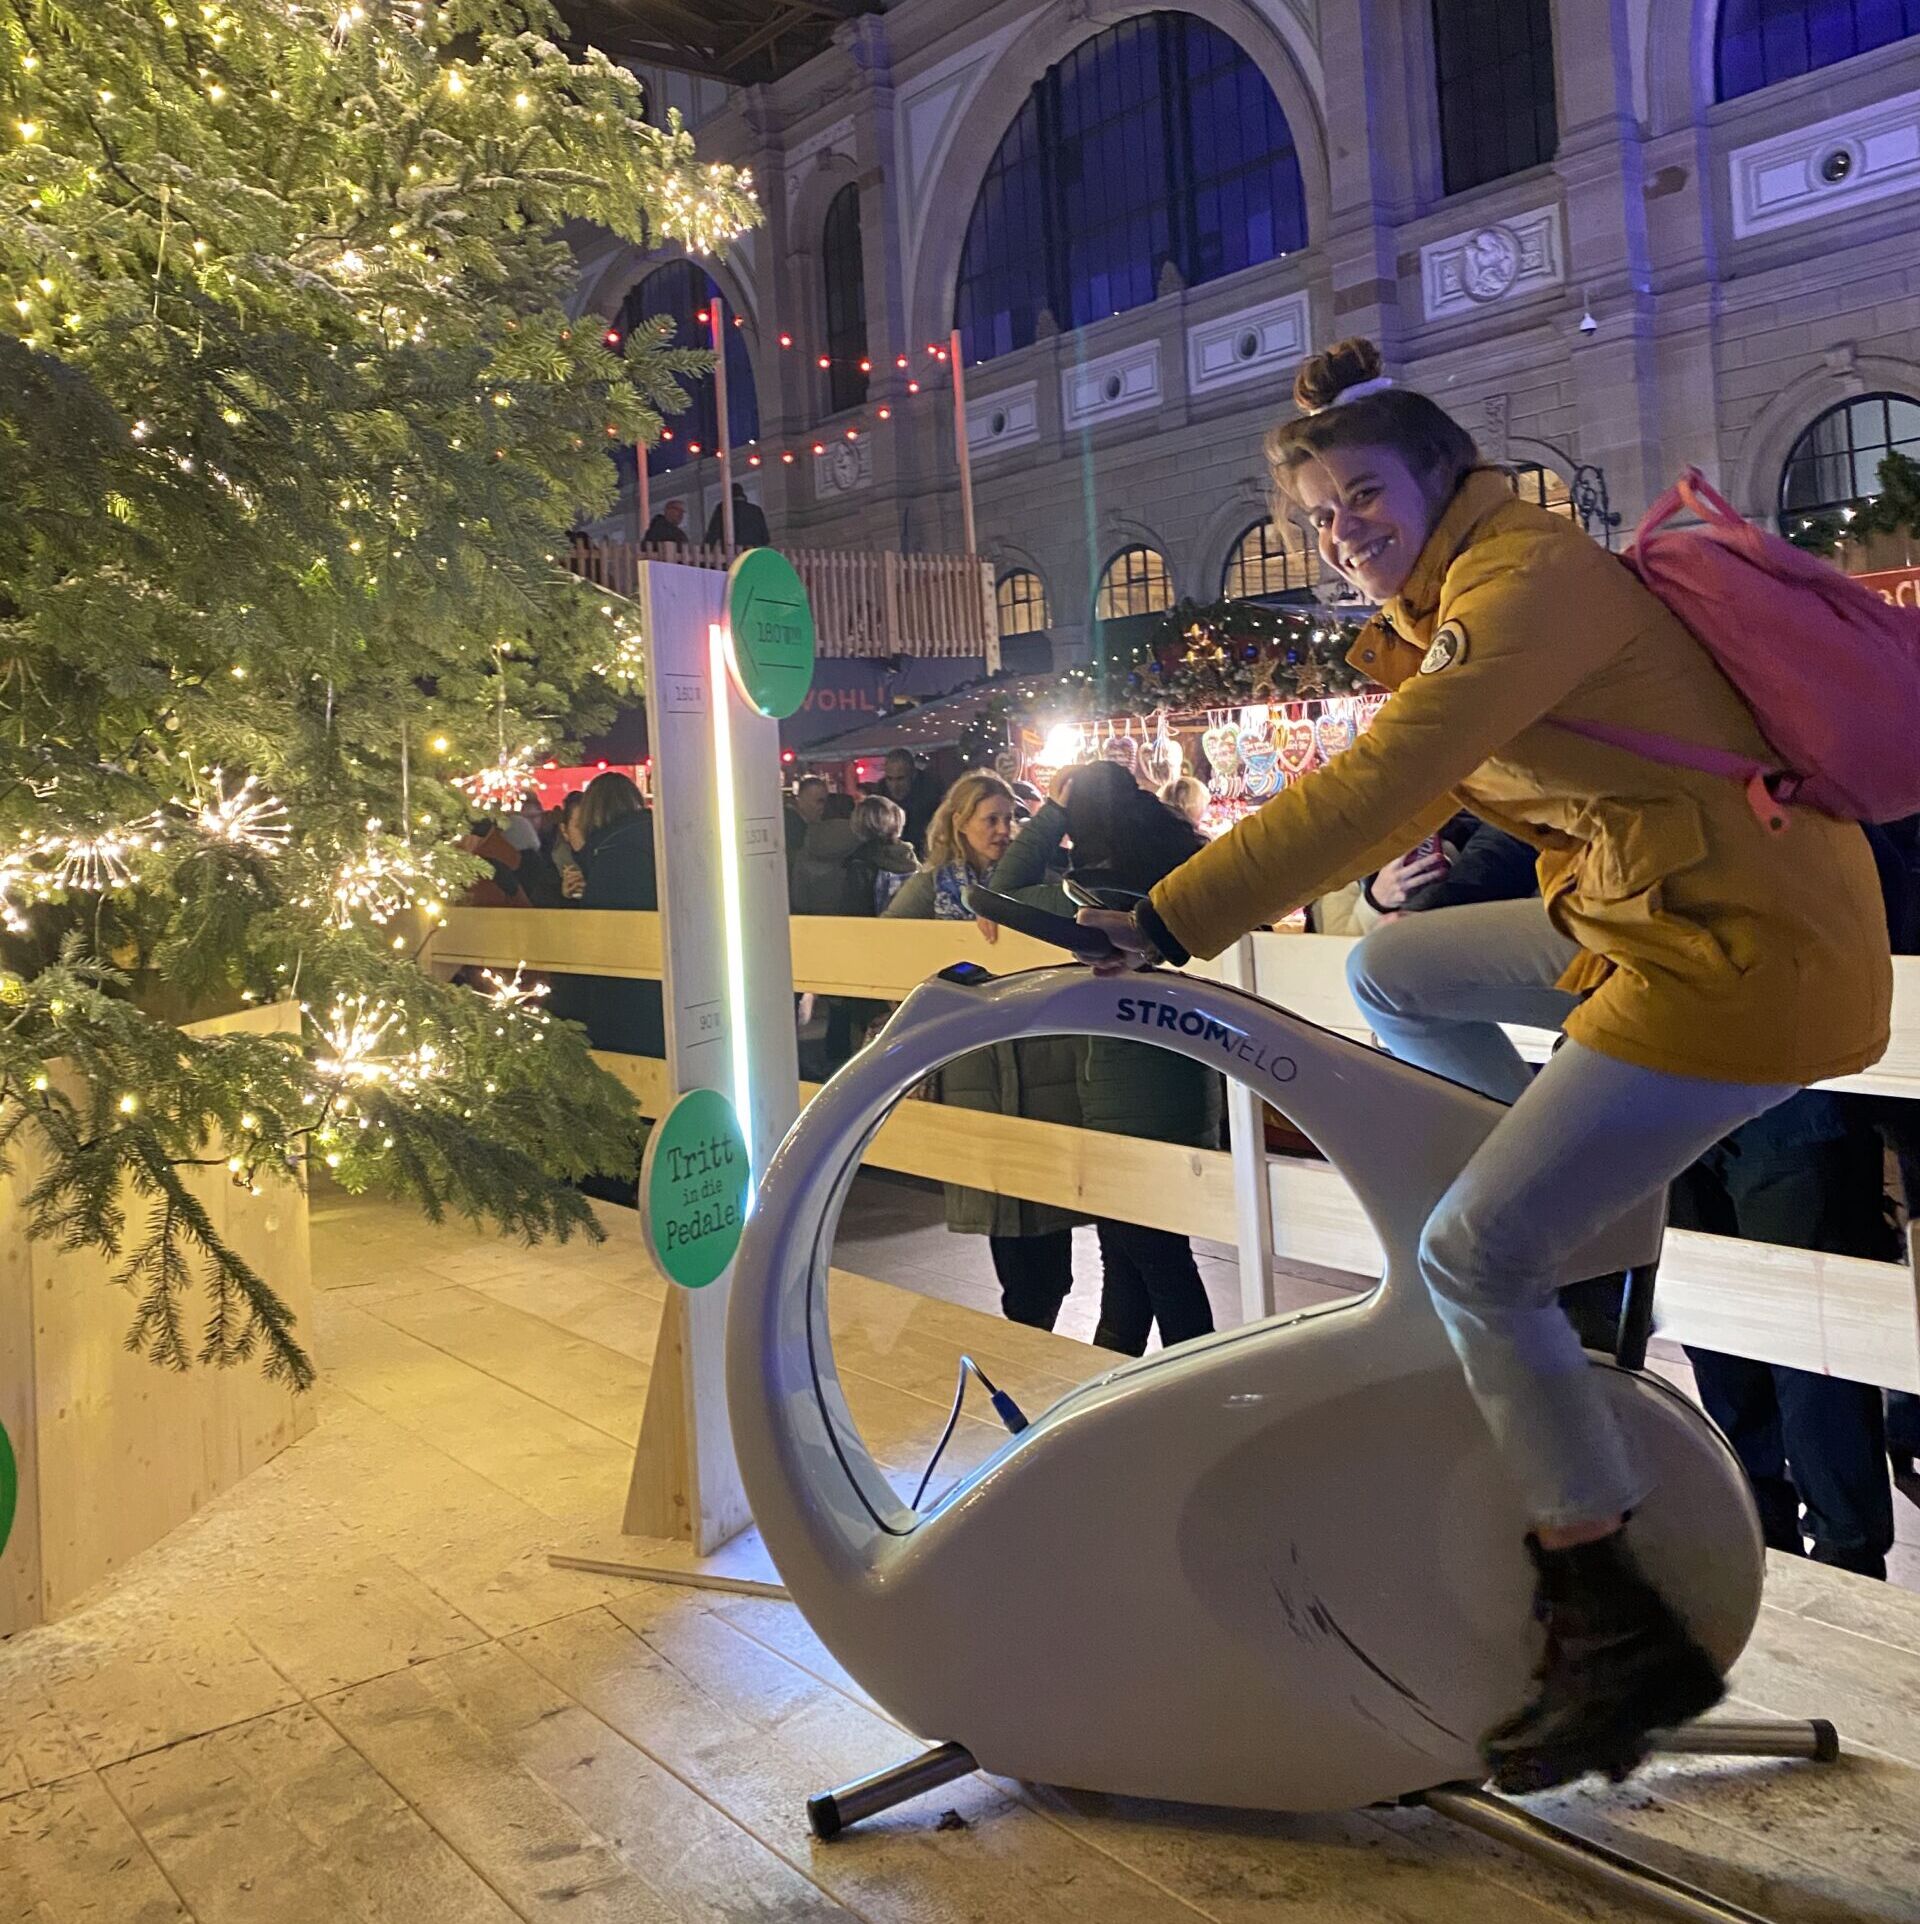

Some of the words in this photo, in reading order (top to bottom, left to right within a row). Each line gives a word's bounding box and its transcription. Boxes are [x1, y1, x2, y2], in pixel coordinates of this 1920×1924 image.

[1116, 998, 1298, 1082] STROMVELO
[667, 1134, 733, 1183] Tritt
[683, 1188, 698, 1206] in
[702, 1180, 722, 1198] die
[666, 1194, 740, 1252] Pedale!
